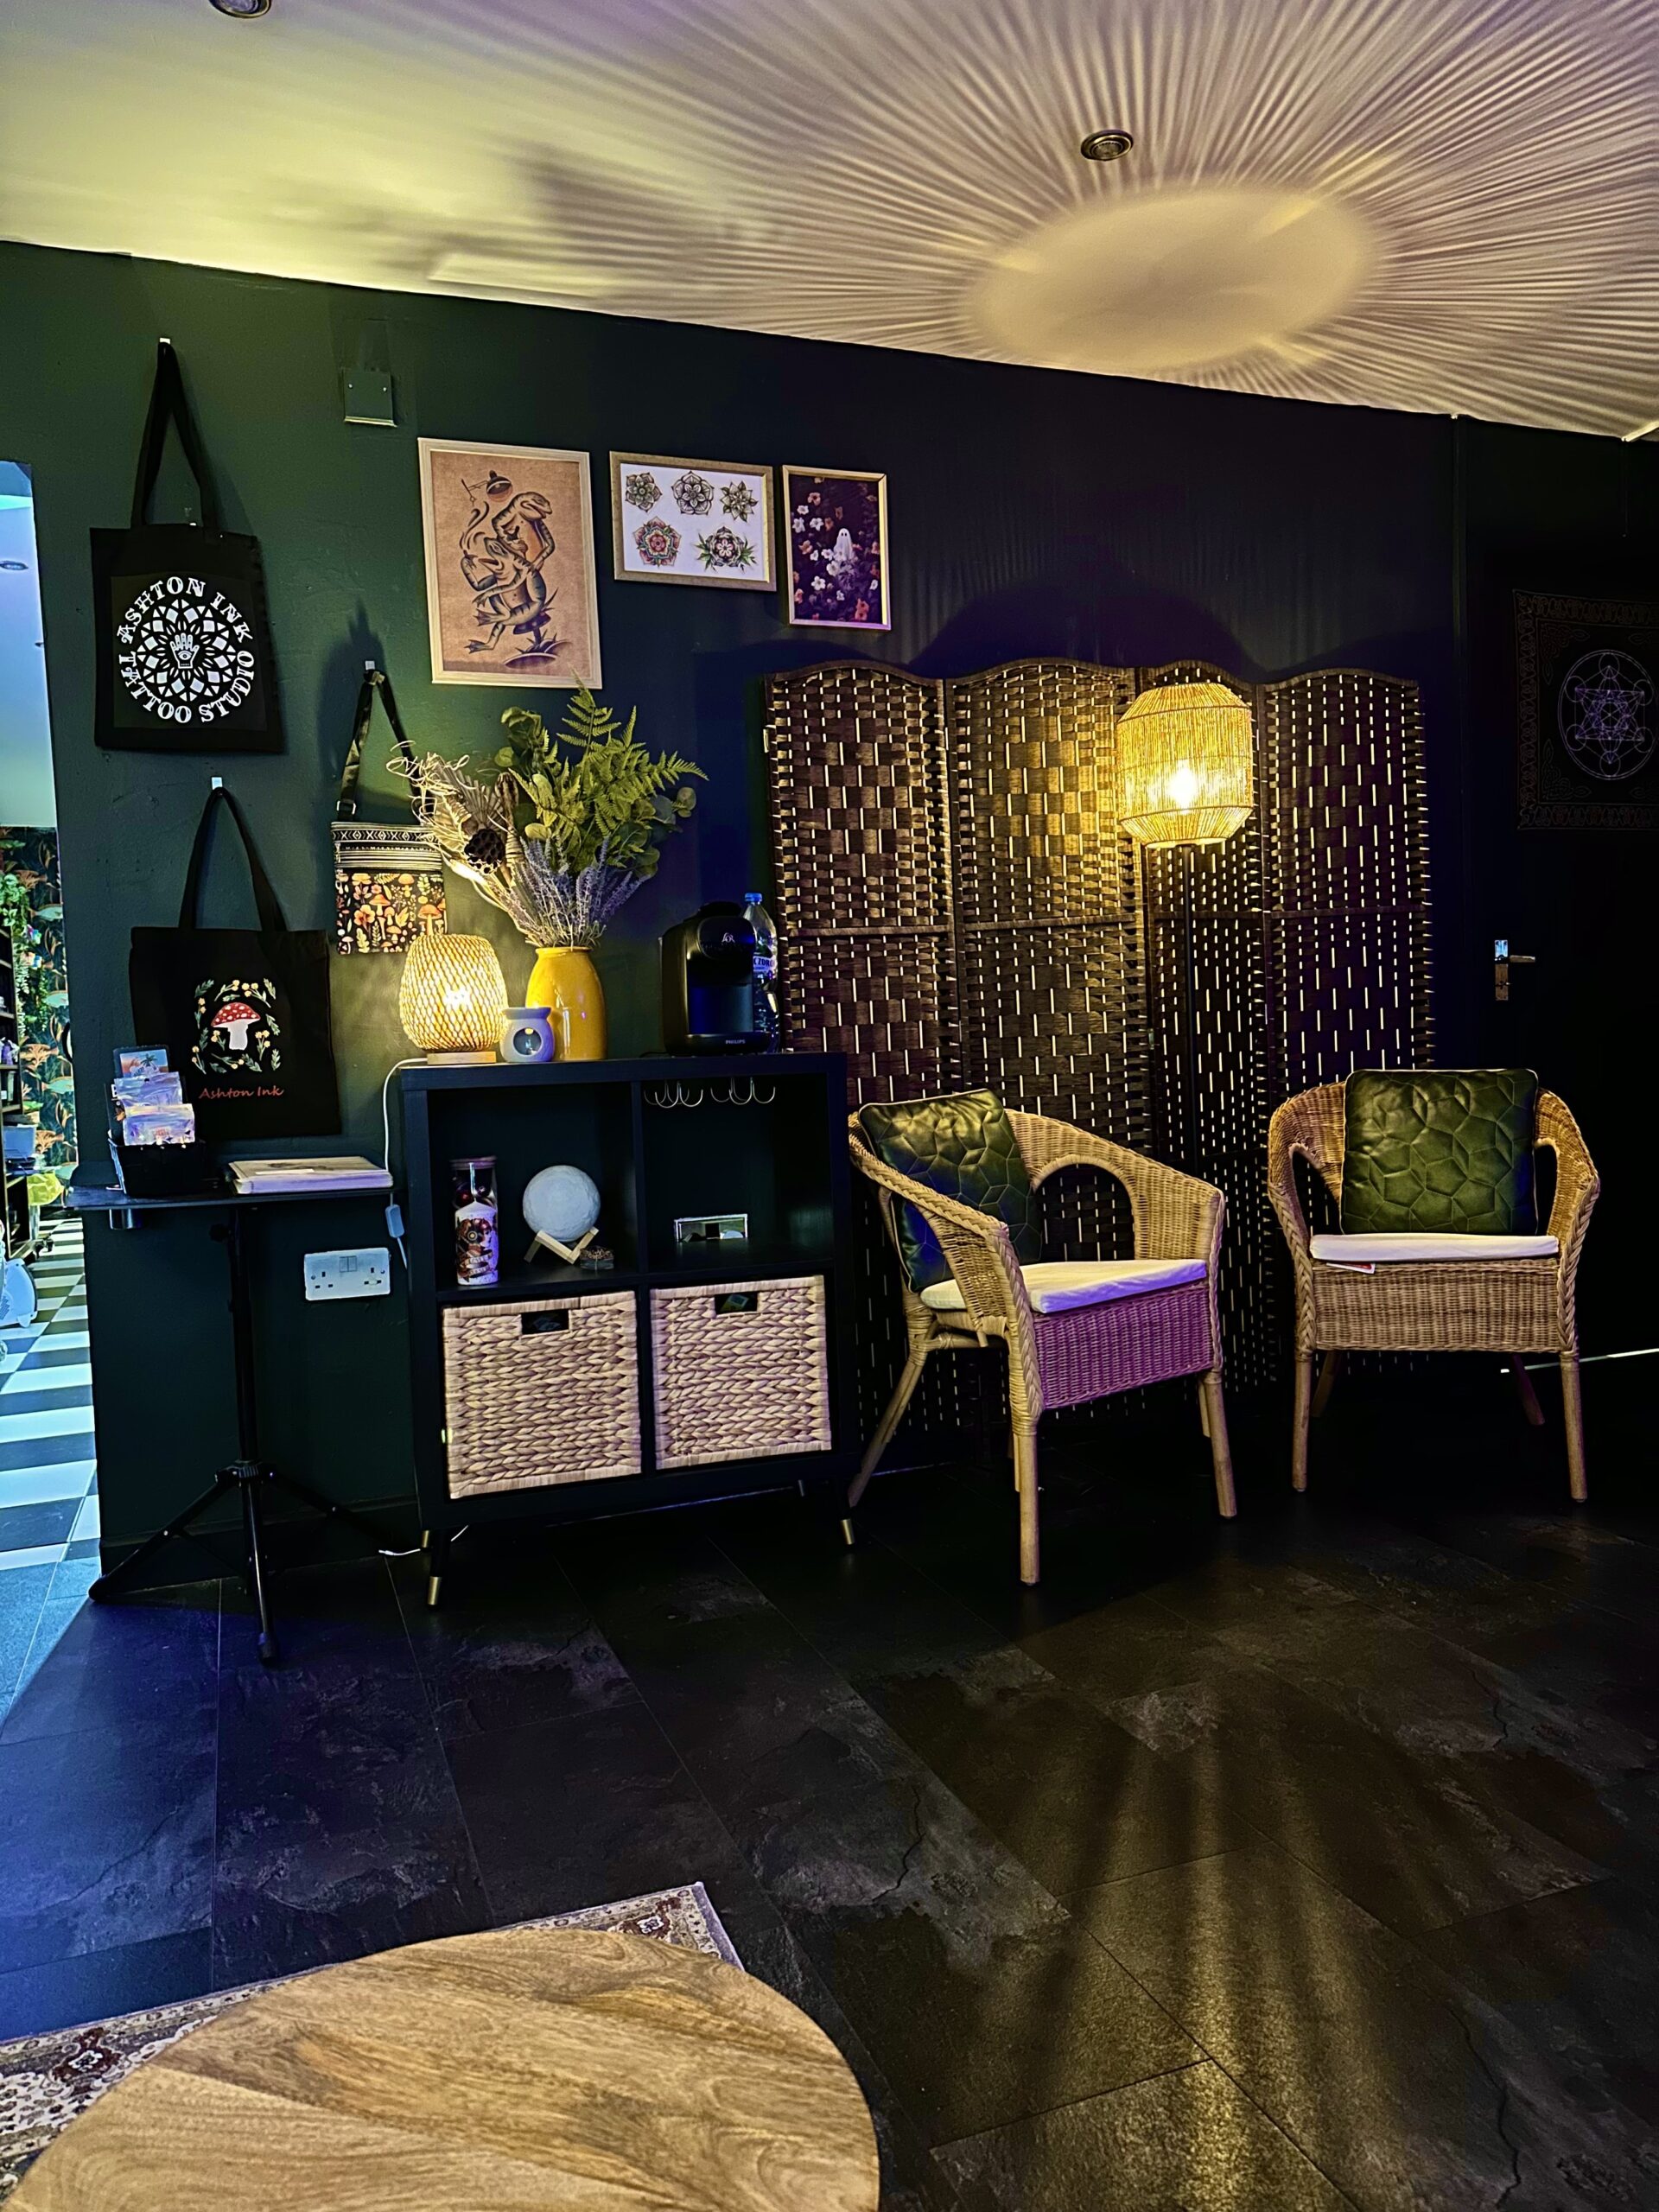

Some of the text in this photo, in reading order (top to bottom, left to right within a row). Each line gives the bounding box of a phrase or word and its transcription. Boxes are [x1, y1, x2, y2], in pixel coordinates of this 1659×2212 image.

[117, 576, 253, 645] ASHTON INK
[118, 651, 255, 723] TATTOO STUDIO
[199, 1085, 284, 1100] Ashton Ink
